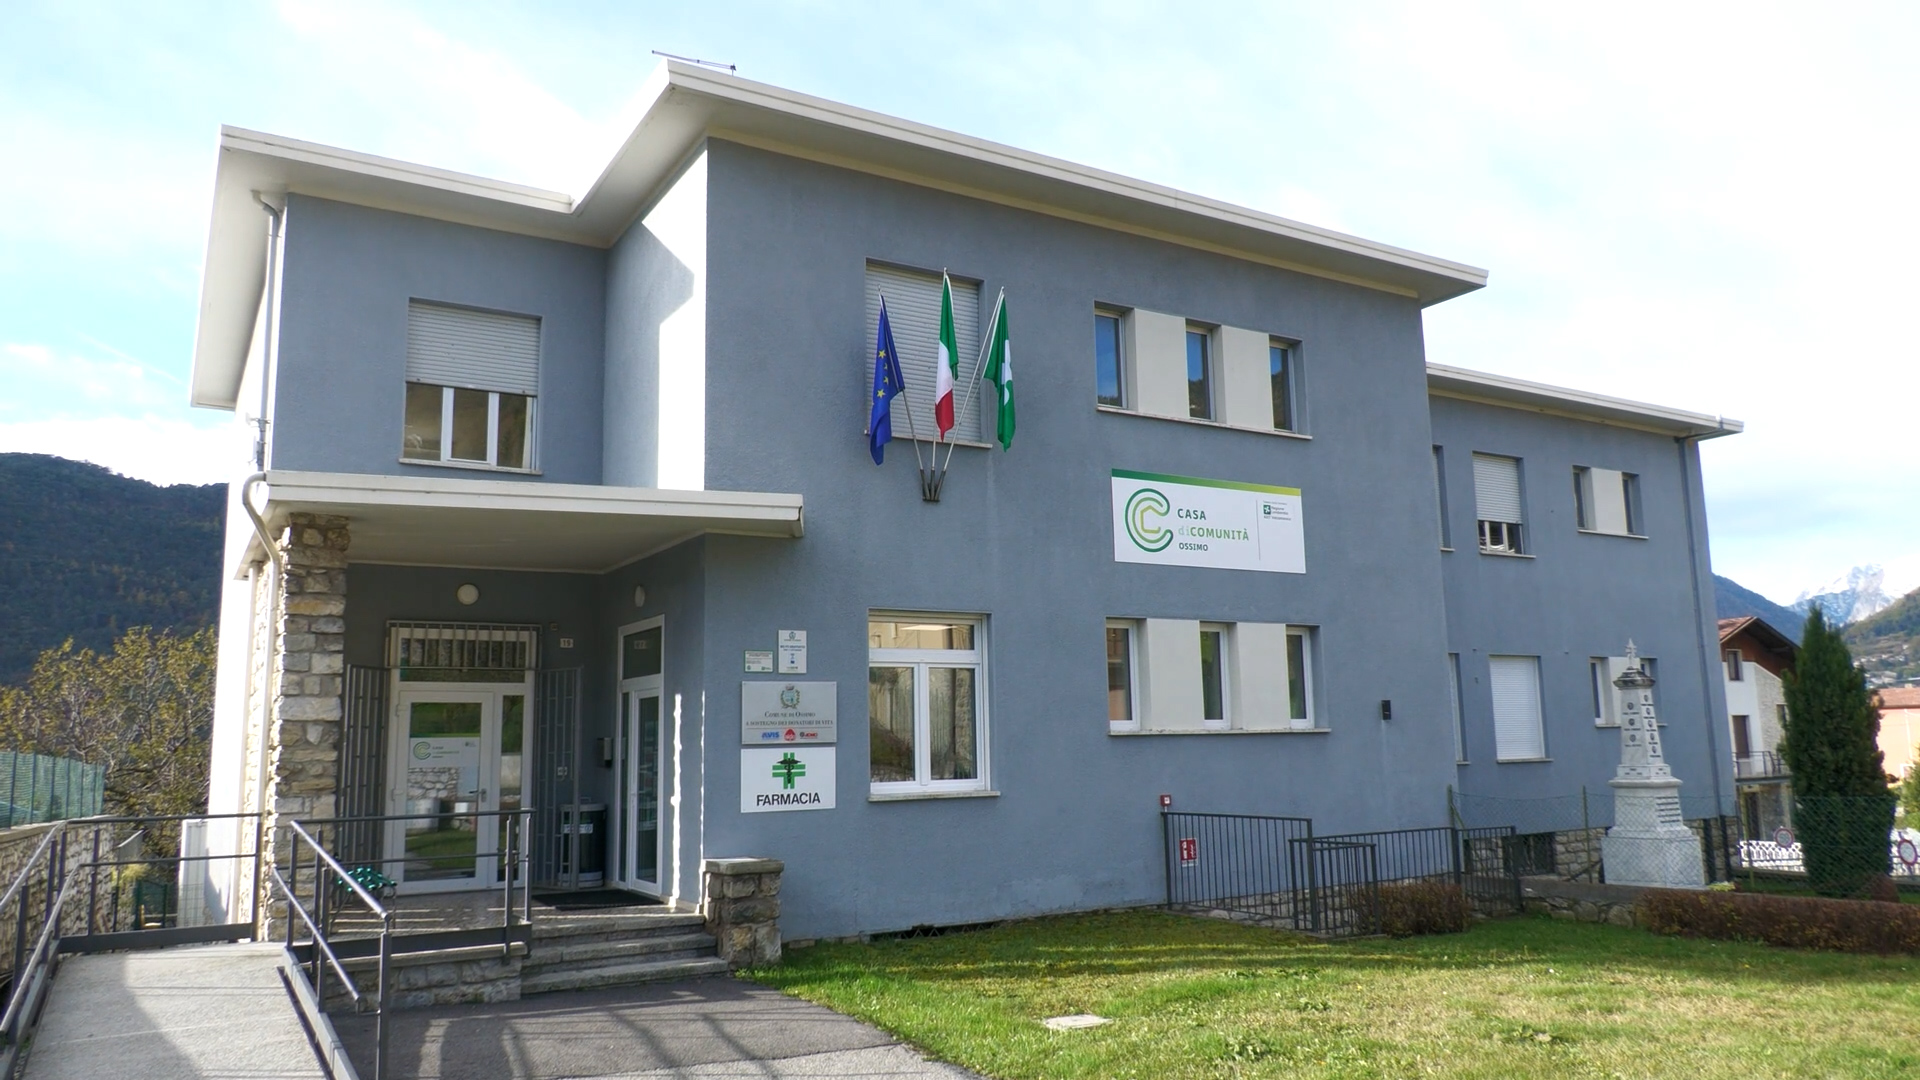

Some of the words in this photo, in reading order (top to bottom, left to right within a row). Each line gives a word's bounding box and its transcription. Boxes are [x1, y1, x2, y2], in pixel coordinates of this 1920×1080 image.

[1177, 508, 1207, 520] CASA
[1178, 542, 1208, 551] OSSIMO
[761, 731, 780, 739] AVIS
[756, 792, 821, 806] FARMACIA
